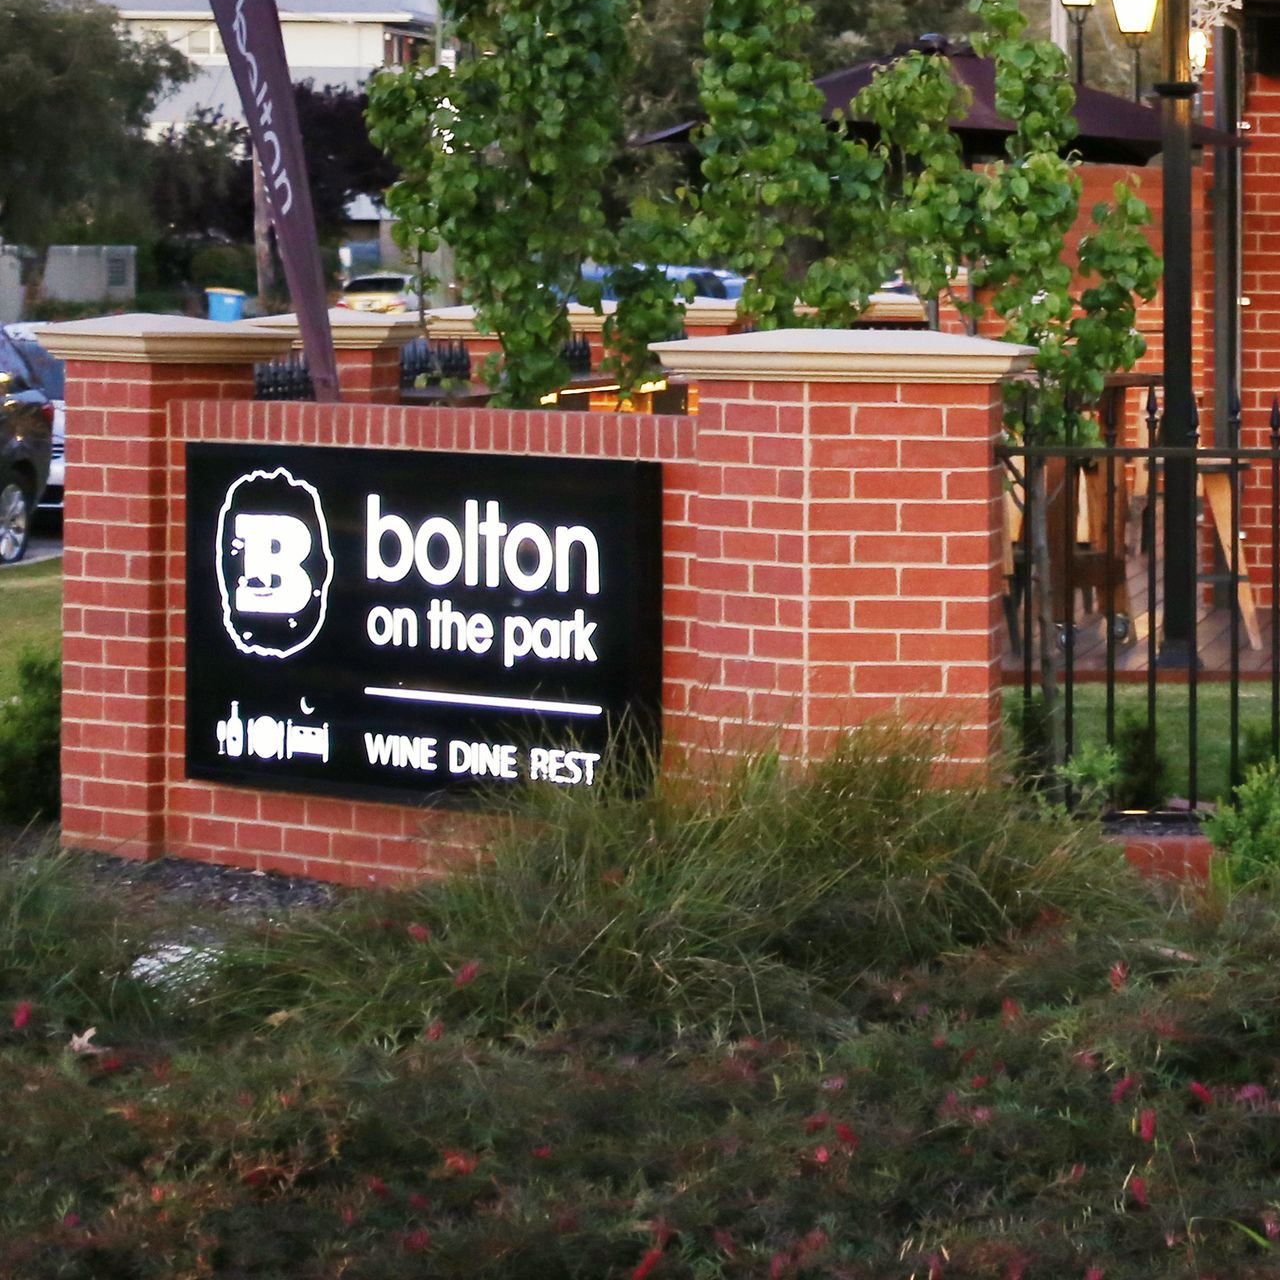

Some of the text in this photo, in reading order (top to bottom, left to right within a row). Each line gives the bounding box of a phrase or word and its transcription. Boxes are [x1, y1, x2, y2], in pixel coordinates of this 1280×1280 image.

[234, 513, 313, 614] B
[366, 493, 600, 595] bolton
[366, 598, 599, 668] on the park
[364, 732, 601, 786] WINE DINE REST
